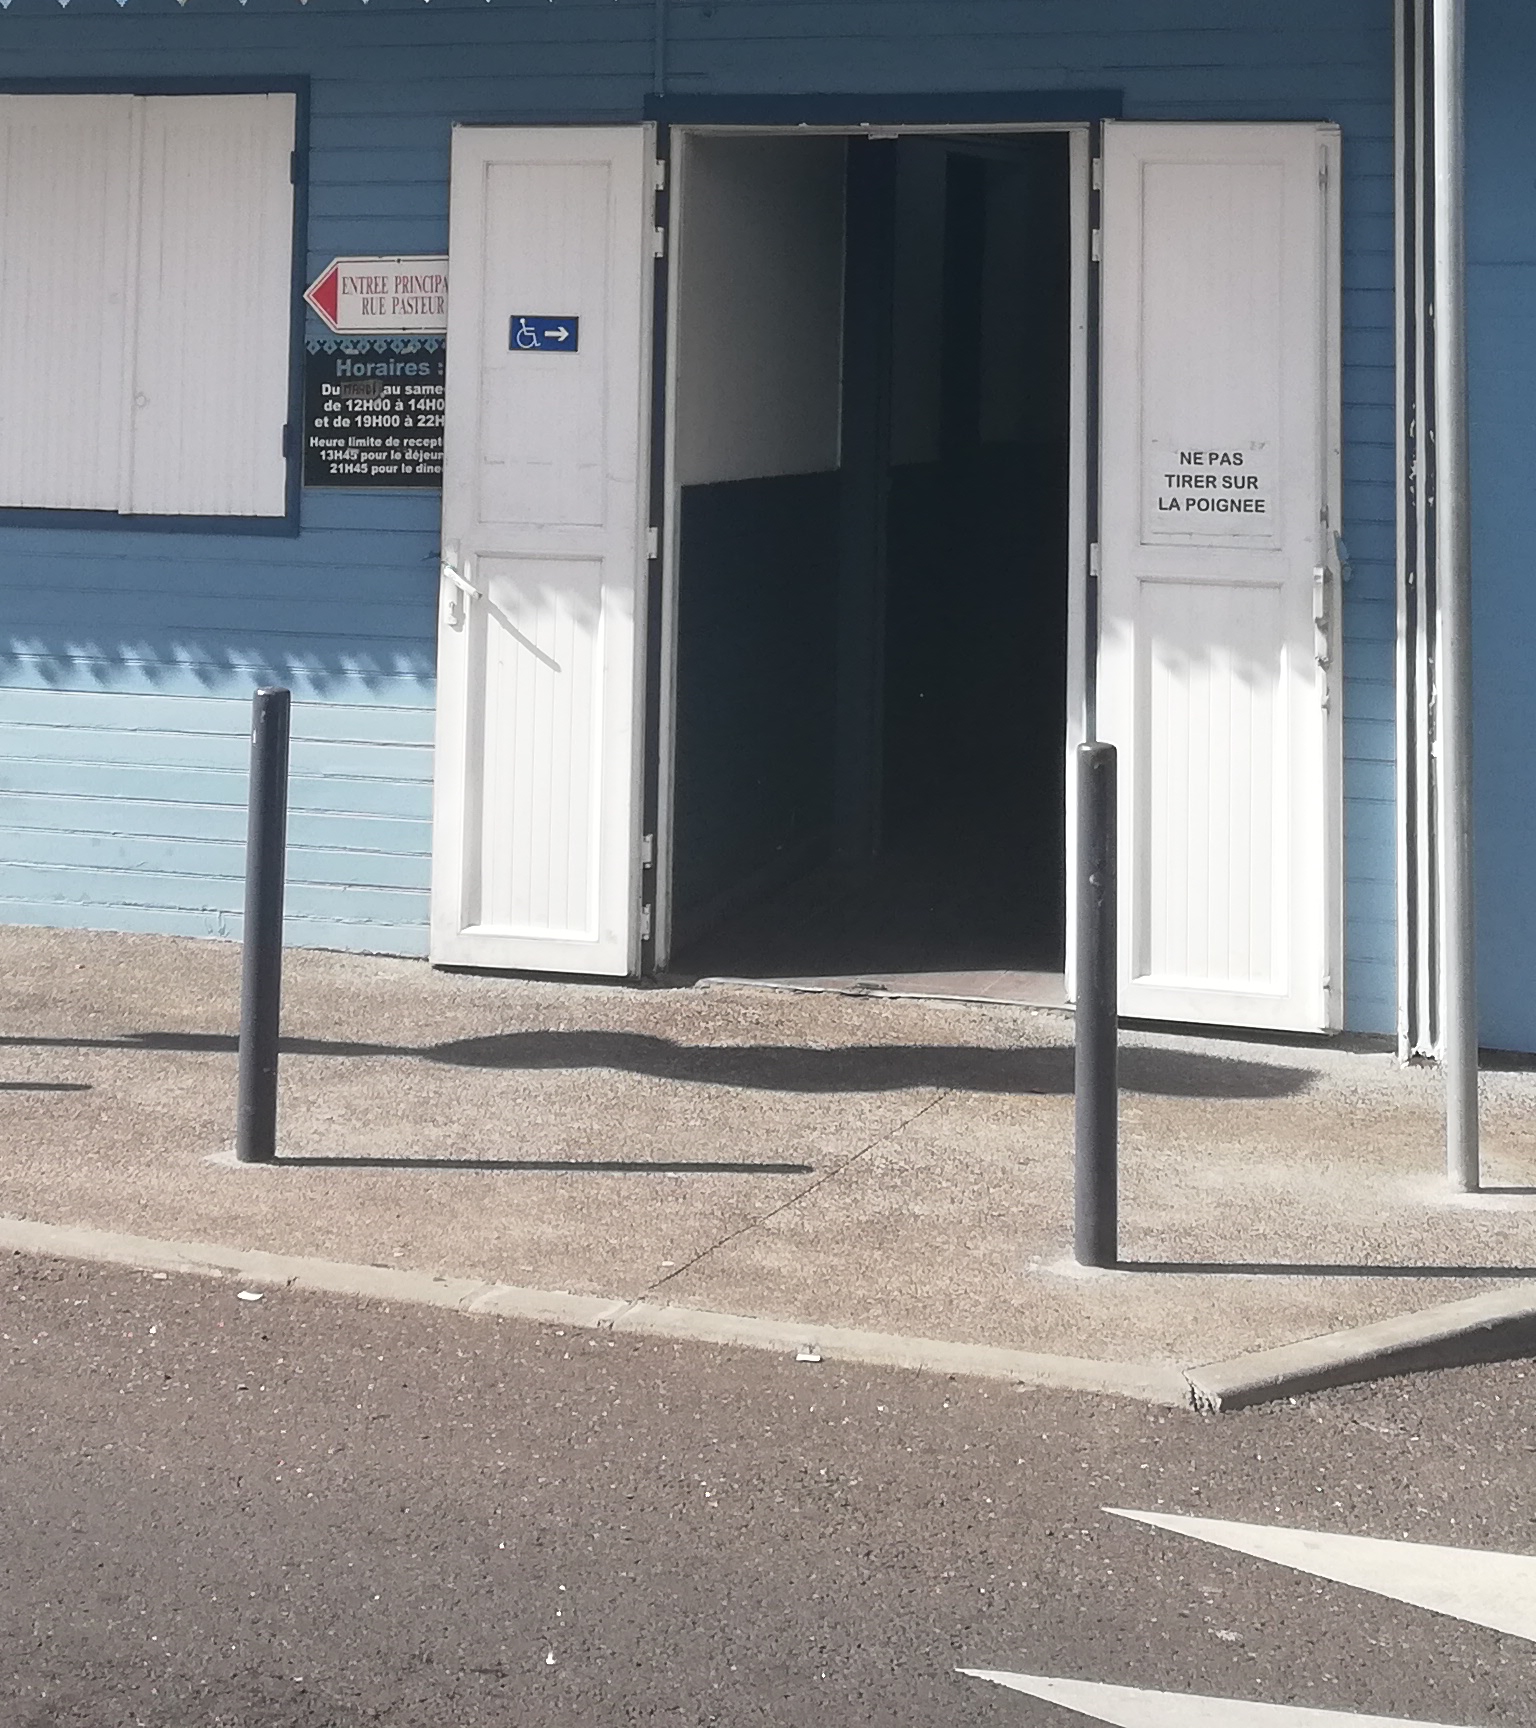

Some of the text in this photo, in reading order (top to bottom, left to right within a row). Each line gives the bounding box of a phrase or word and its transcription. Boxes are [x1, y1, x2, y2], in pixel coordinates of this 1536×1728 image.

[341, 274, 449, 295] ENTREE PRINCIPA
[361, 295, 445, 316] RUE PASTEUR
[336, 358, 431, 377] Horaires
[321, 383, 341, 396] Du
[383, 385, 401, 395] au
[404, 385, 444, 395] same
[323, 398, 445, 412] de 12H00 à 14H0
[314, 415, 445, 428] et de 19H00 à 22H
[309, 436, 442, 449] Heure limite de recept
[319, 449, 358, 461] 13H45
[360, 451, 388, 462] pour
[390, 449, 402, 460] le
[1179, 451, 1244, 466] NE PAS
[329, 463, 443, 476] 21H45 pour le dine
[1164, 474, 1259, 490] TIRER SUR
[1158, 497, 1266, 513] LA POIGNEE
